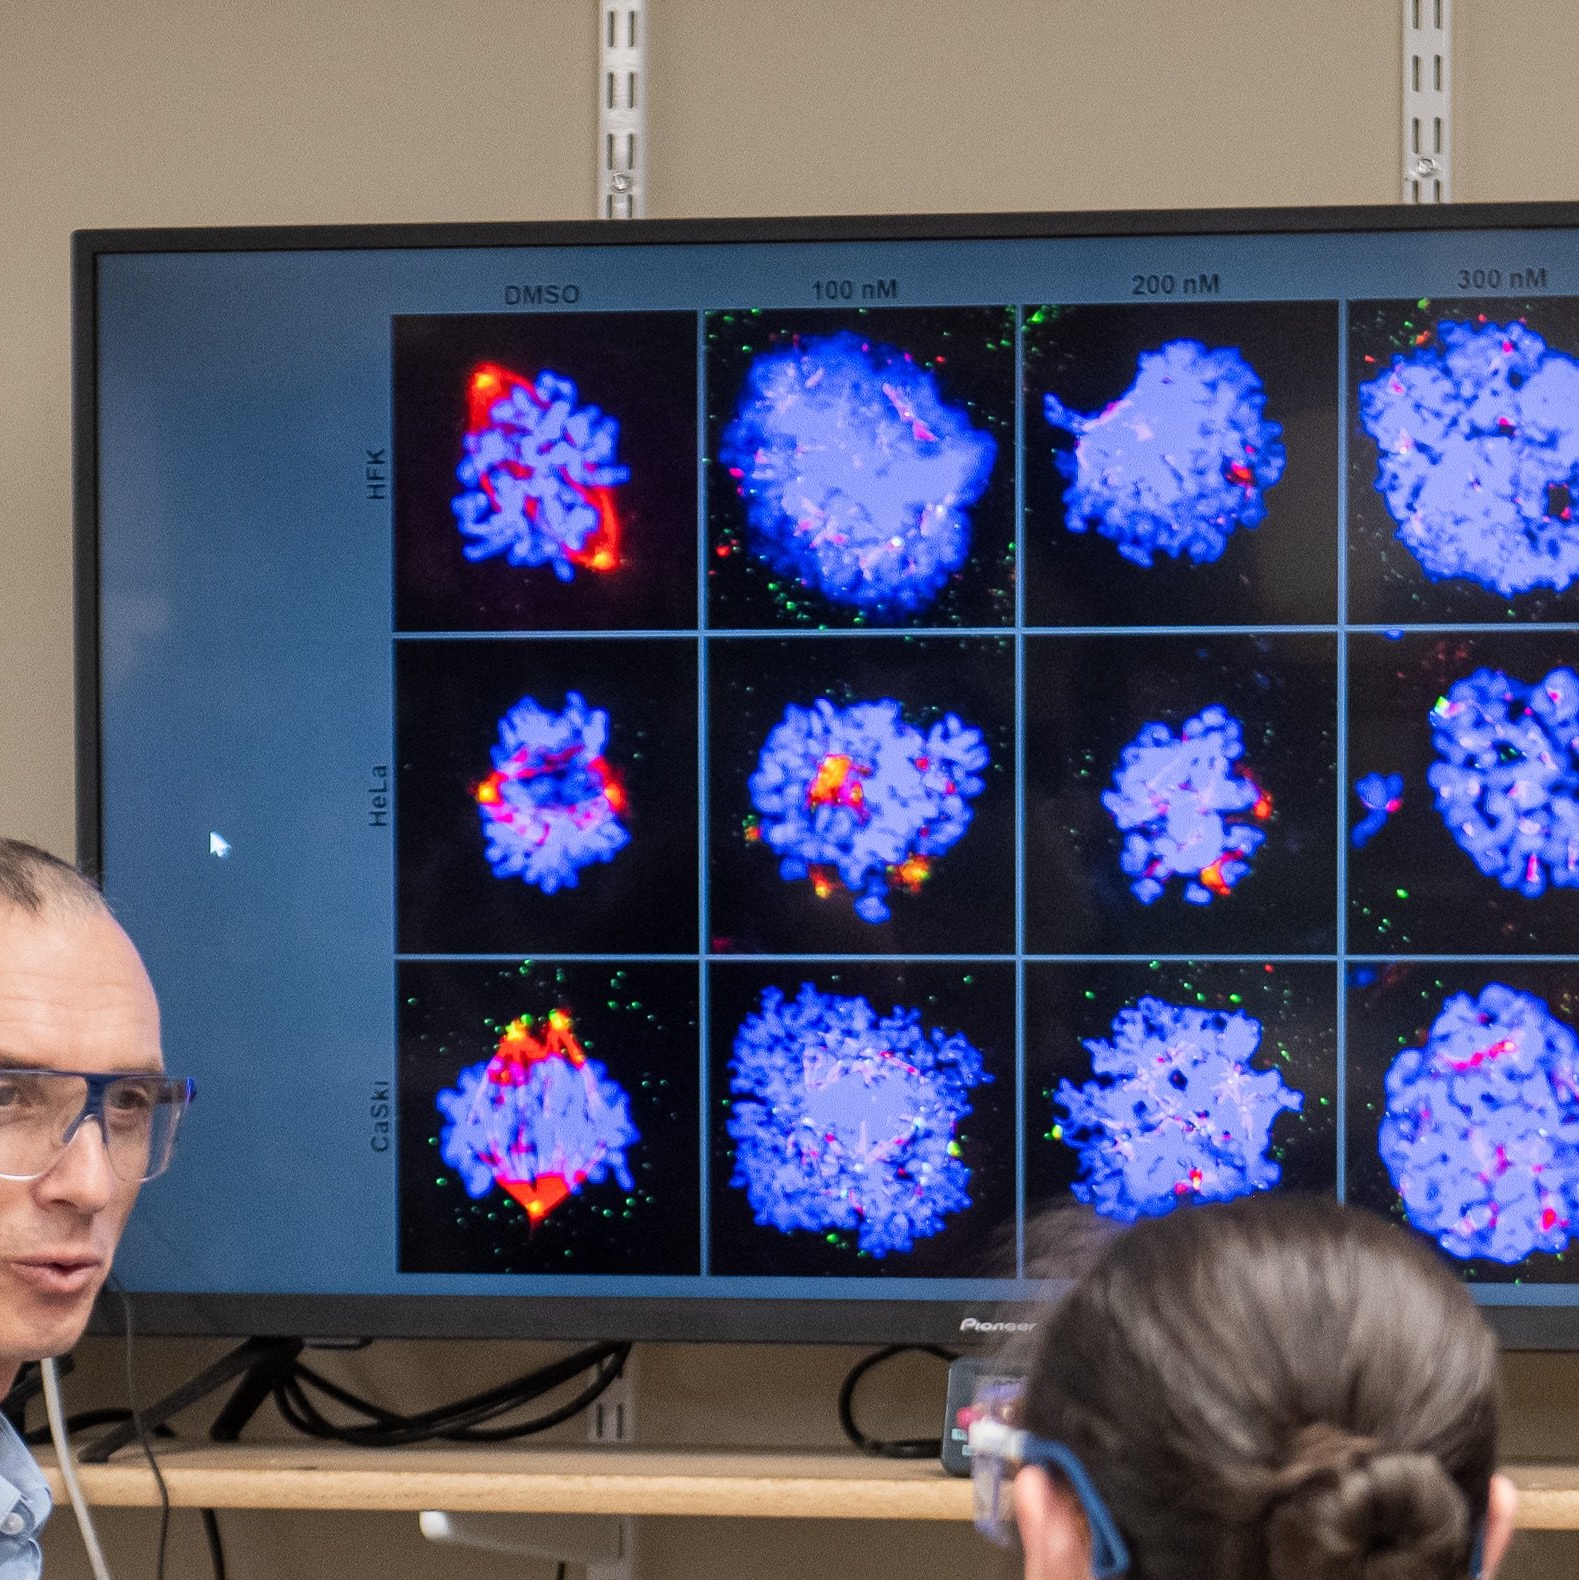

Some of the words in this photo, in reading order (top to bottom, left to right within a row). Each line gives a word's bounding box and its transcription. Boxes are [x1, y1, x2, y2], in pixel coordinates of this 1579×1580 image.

[1131, 274, 1175, 295] 200
[1183, 273, 1219, 294] nM
[1458, 268, 1501, 289] 300
[1510, 267, 1547, 289] nM
[504, 284, 580, 305] DMSO
[811, 280, 853, 300] 100
[861, 279, 898, 299] nM
[365, 448, 386, 500] HFK
[368, 765, 388, 827] HeLa
[370, 1081, 390, 1153] CaSki
[960, 1317, 1038, 1332] Pioneer
